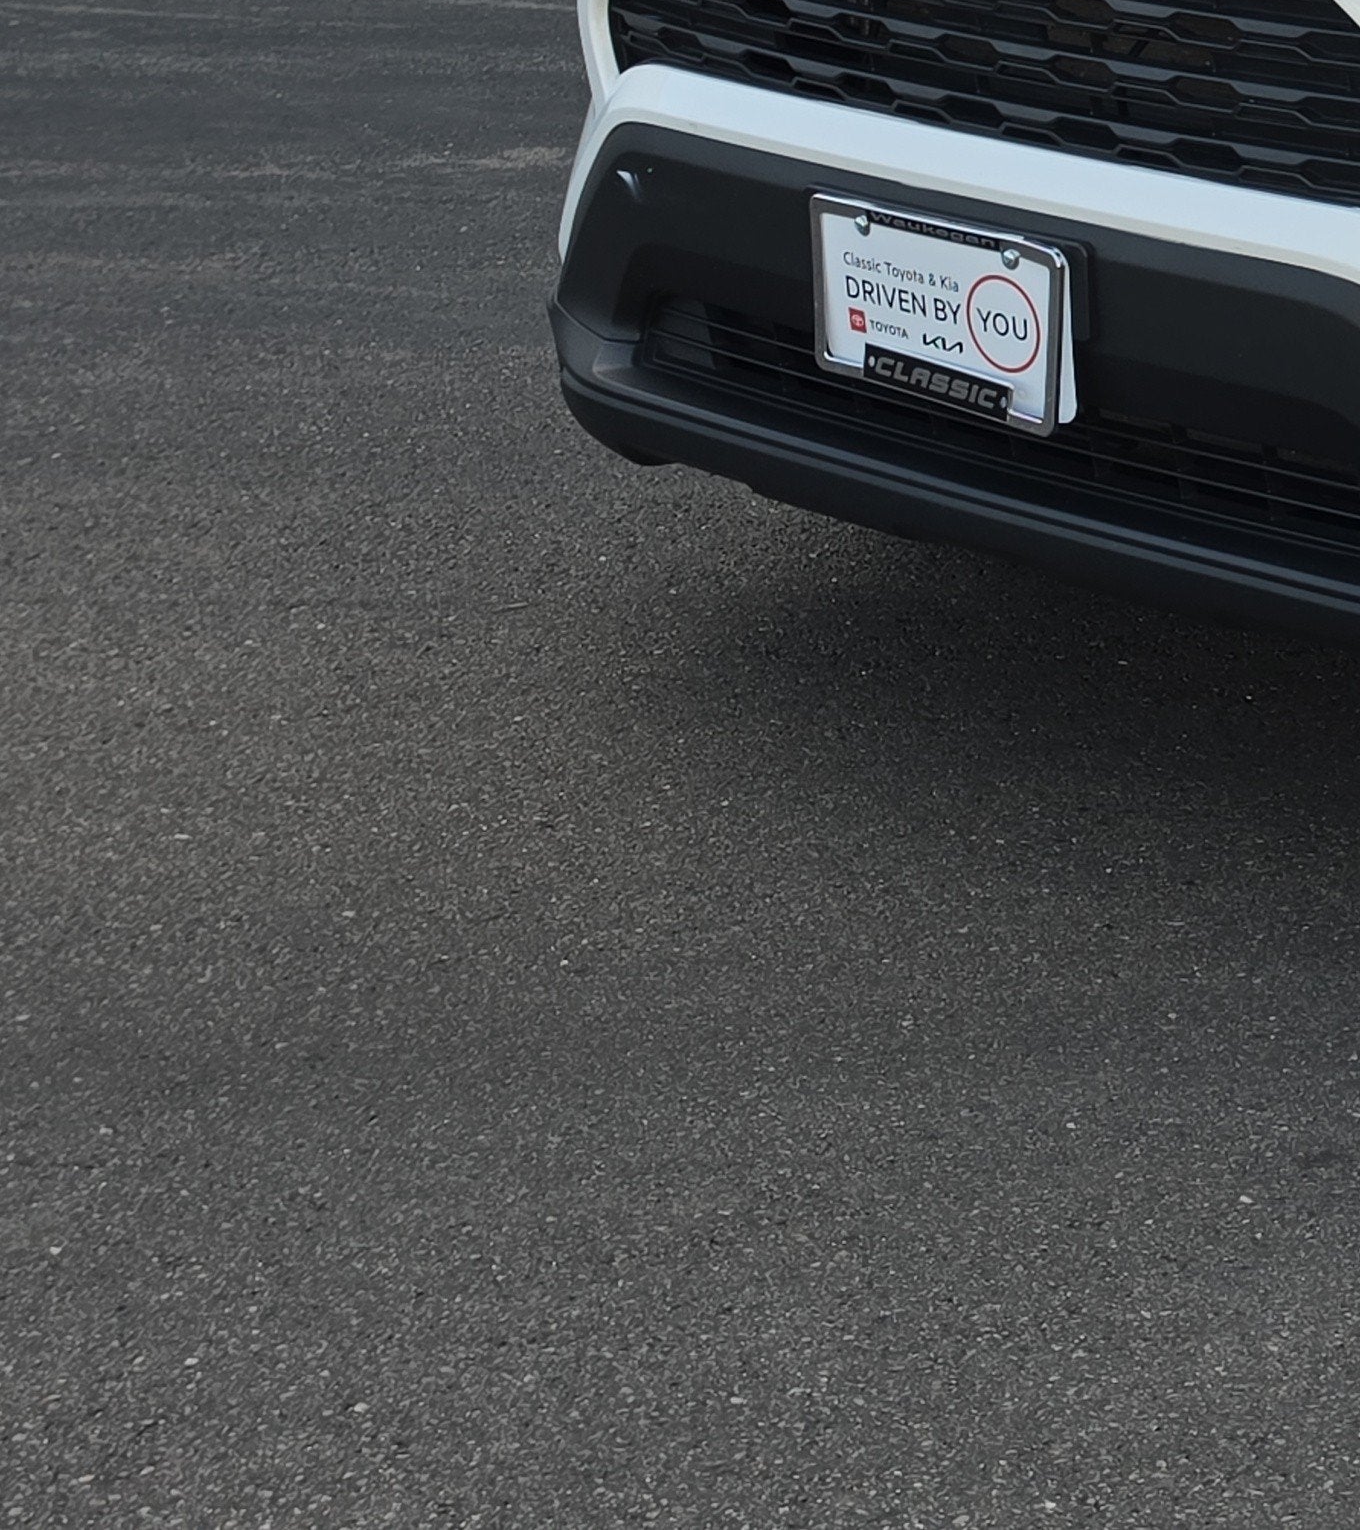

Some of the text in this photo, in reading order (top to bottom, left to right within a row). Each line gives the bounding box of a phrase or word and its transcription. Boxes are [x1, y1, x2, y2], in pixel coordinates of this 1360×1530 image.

[870, 211, 996, 248] Waukegan
[843, 251, 959, 293] Classic Toyota & Kia
[845, 275, 1028, 341] DRIVEN BY YOU
[869, 319, 909, 340] TOYOTA
[875, 356, 998, 409] CLASSIC
